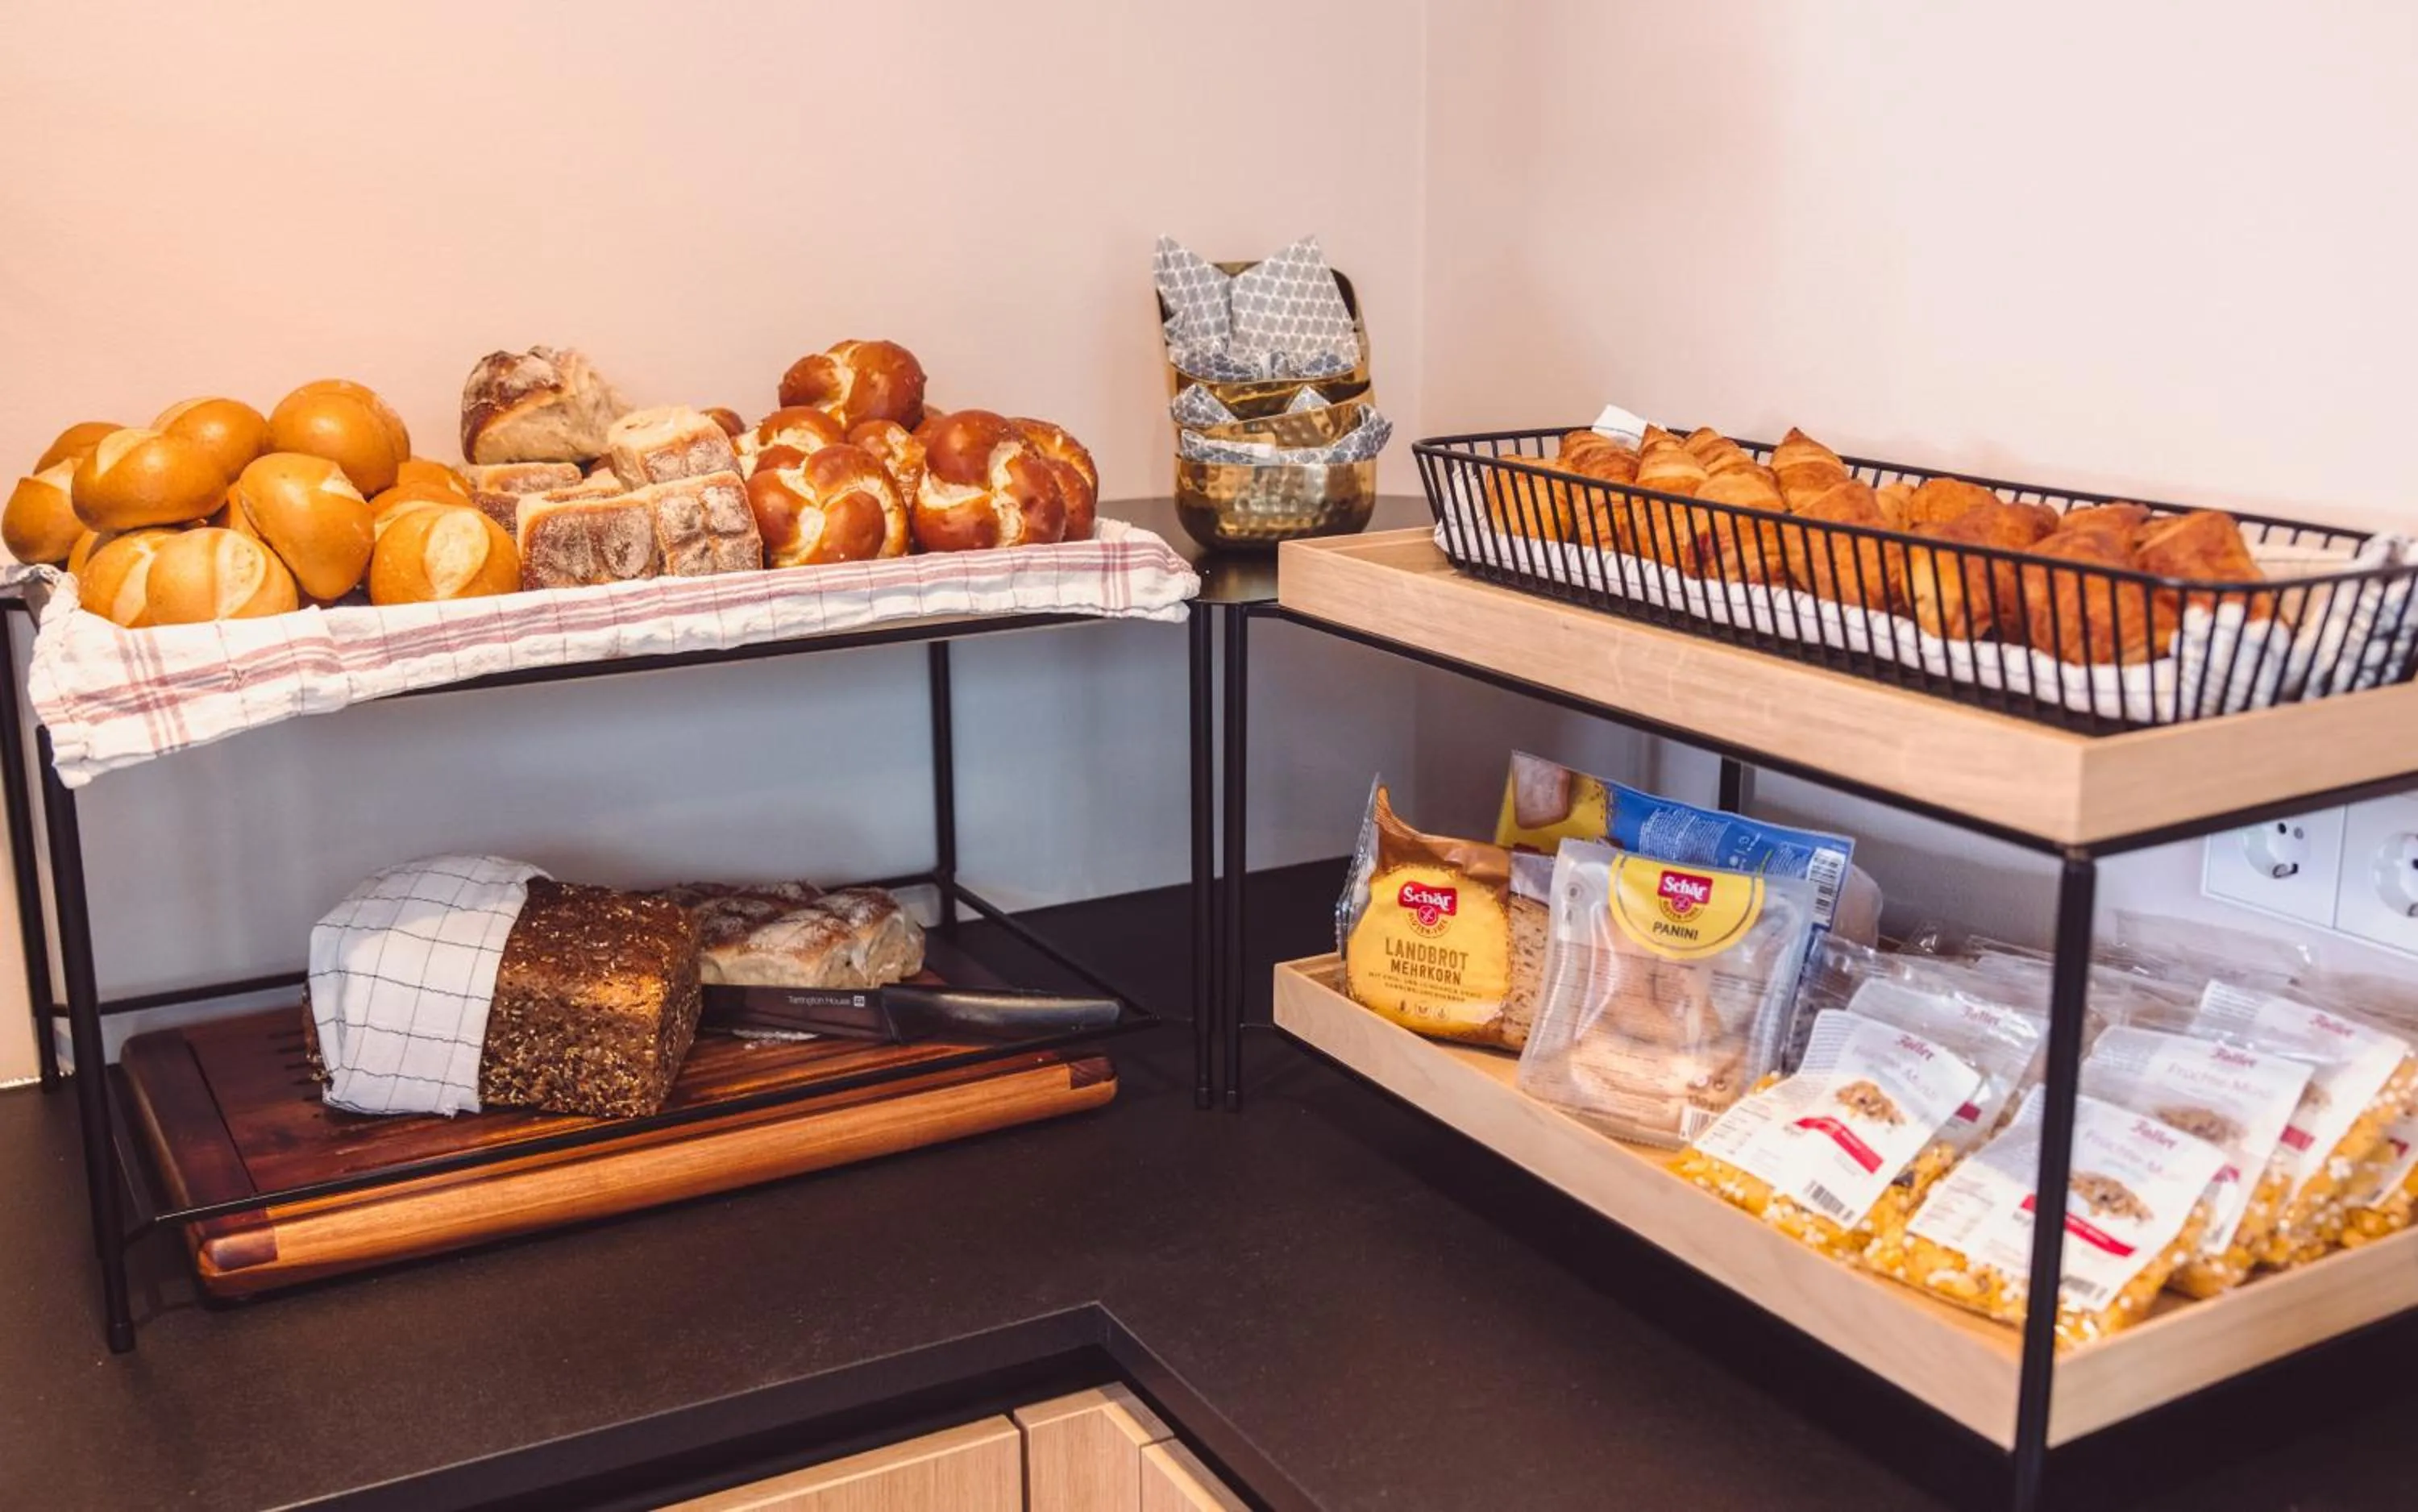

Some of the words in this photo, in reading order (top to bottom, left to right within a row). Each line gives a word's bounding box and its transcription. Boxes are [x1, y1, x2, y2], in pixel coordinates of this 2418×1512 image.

[1403, 885, 1452, 912] Schär
[1663, 876, 1707, 901] Schär
[1652, 920, 1698, 941] PANINI
[1385, 937, 1469, 971] LANDBROT
[1390, 958, 1462, 986] MEHRKORN
